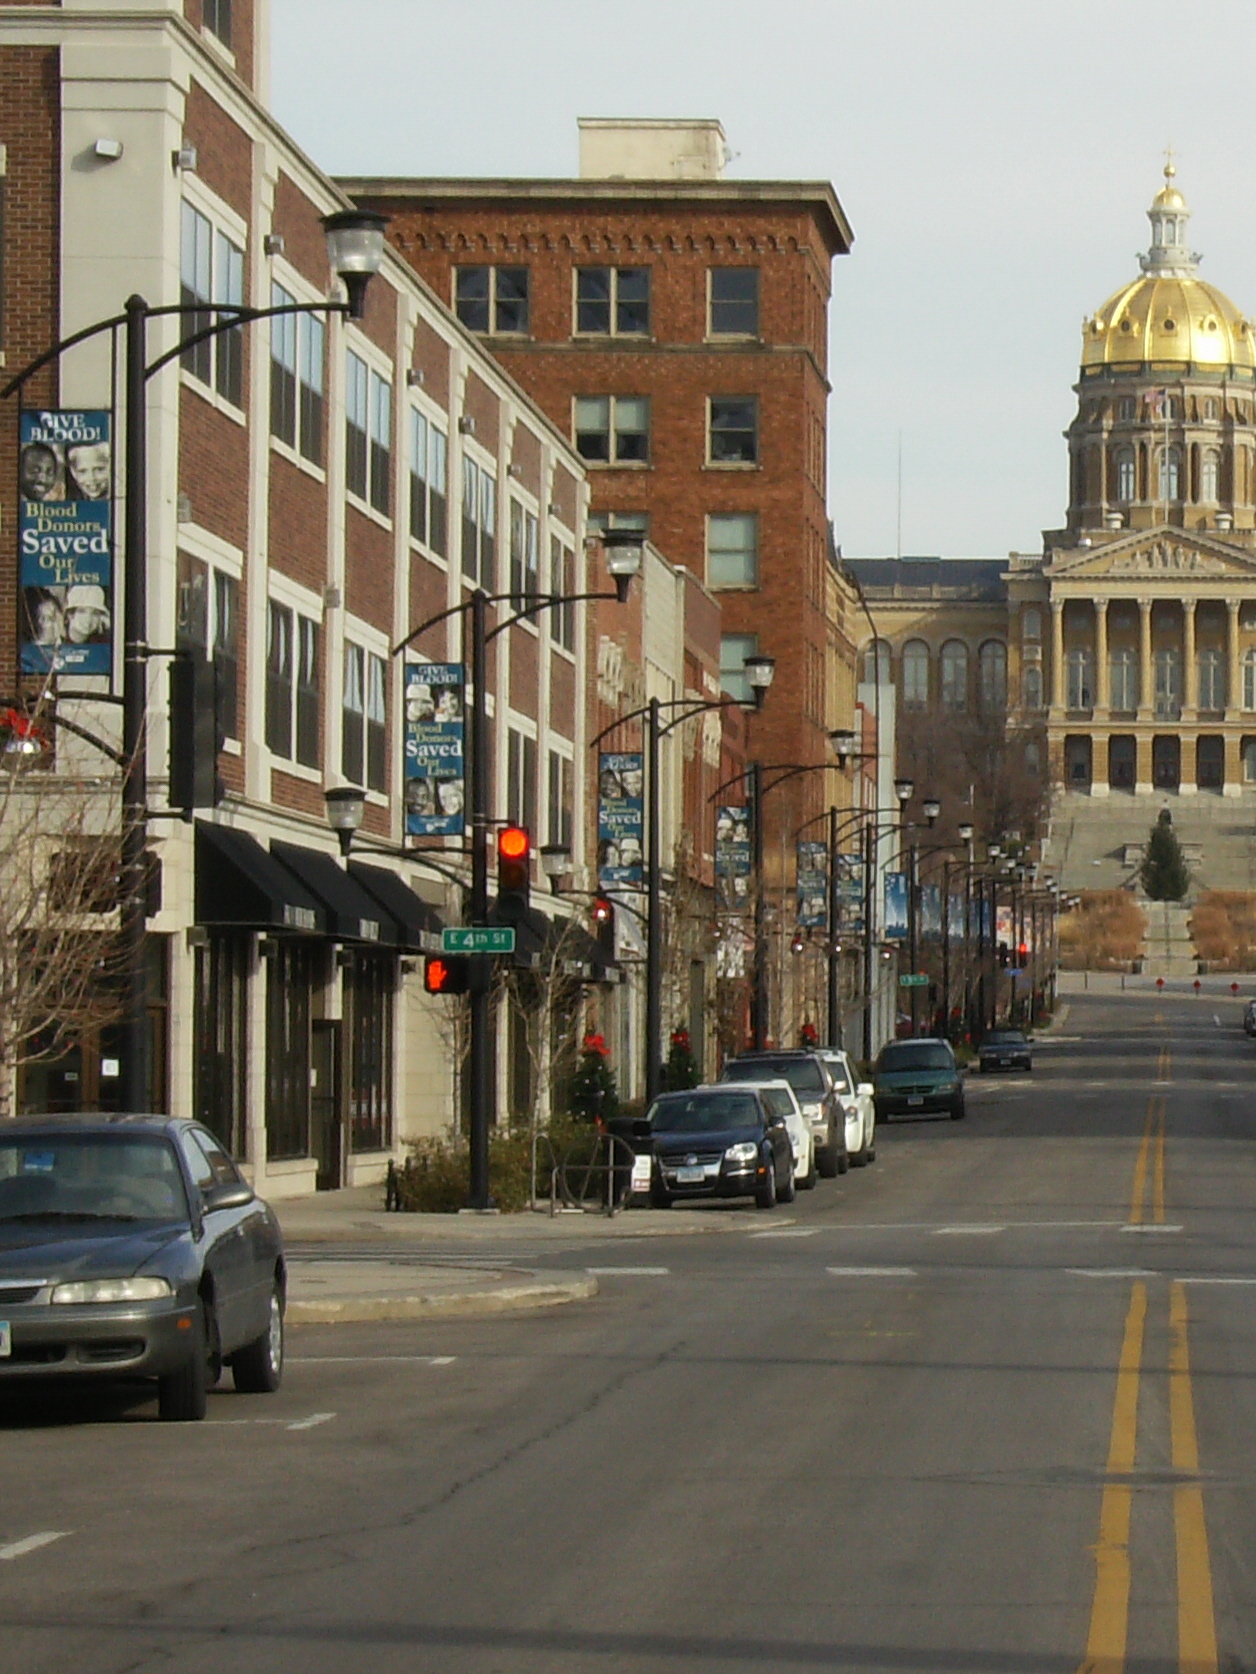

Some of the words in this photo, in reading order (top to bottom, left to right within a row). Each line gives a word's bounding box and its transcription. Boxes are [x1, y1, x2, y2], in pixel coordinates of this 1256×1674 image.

[40, 412, 86, 428] GIVE
[31, 427, 101, 441] BLOOD!
[26, 502, 78, 517] Blood
[38, 518, 101, 532] Donors
[22, 528, 109, 554] Saved
[39, 554, 74, 568] Our
[55, 568, 100, 583] Lives
[406, 739, 463, 757] Saved
[599, 811, 641, 824] Saved
[450, 932, 458, 944] E
[462, 932, 488, 948] 4th
[493, 932, 506, 944] St
